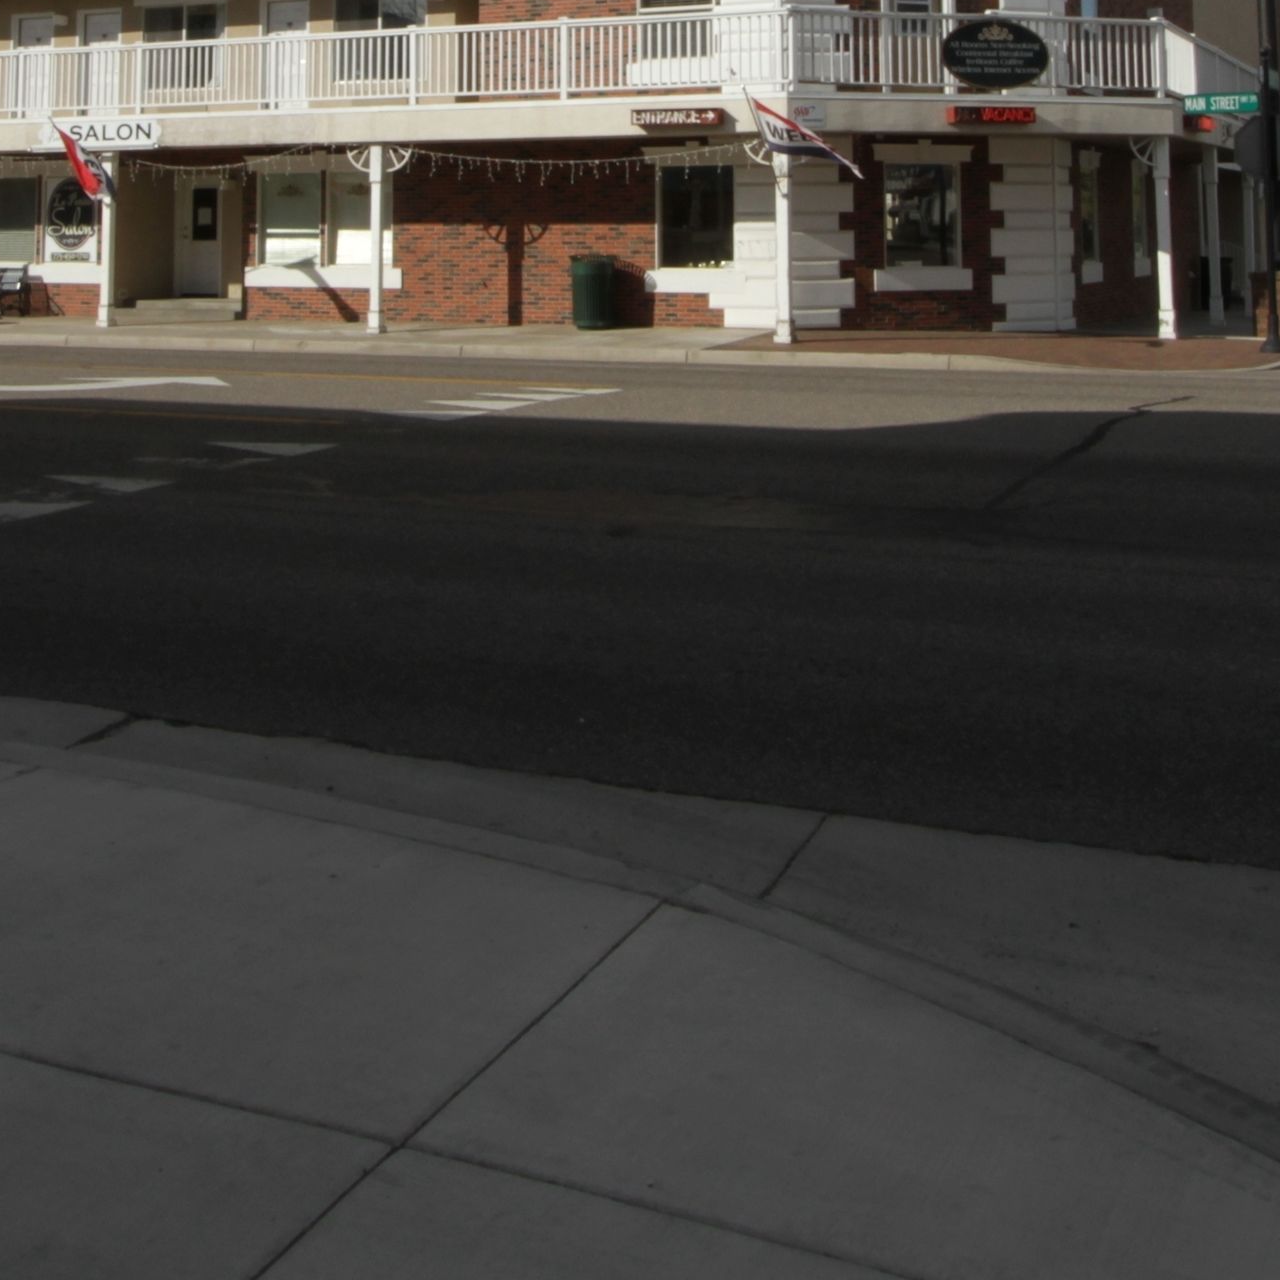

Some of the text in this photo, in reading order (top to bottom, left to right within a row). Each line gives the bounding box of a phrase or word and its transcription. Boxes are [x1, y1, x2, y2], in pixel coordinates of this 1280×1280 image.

[1185, 97, 1206, 111] MAIN
[1210, 95, 1239, 110] STREET
[70, 123, 151, 140] SALON
